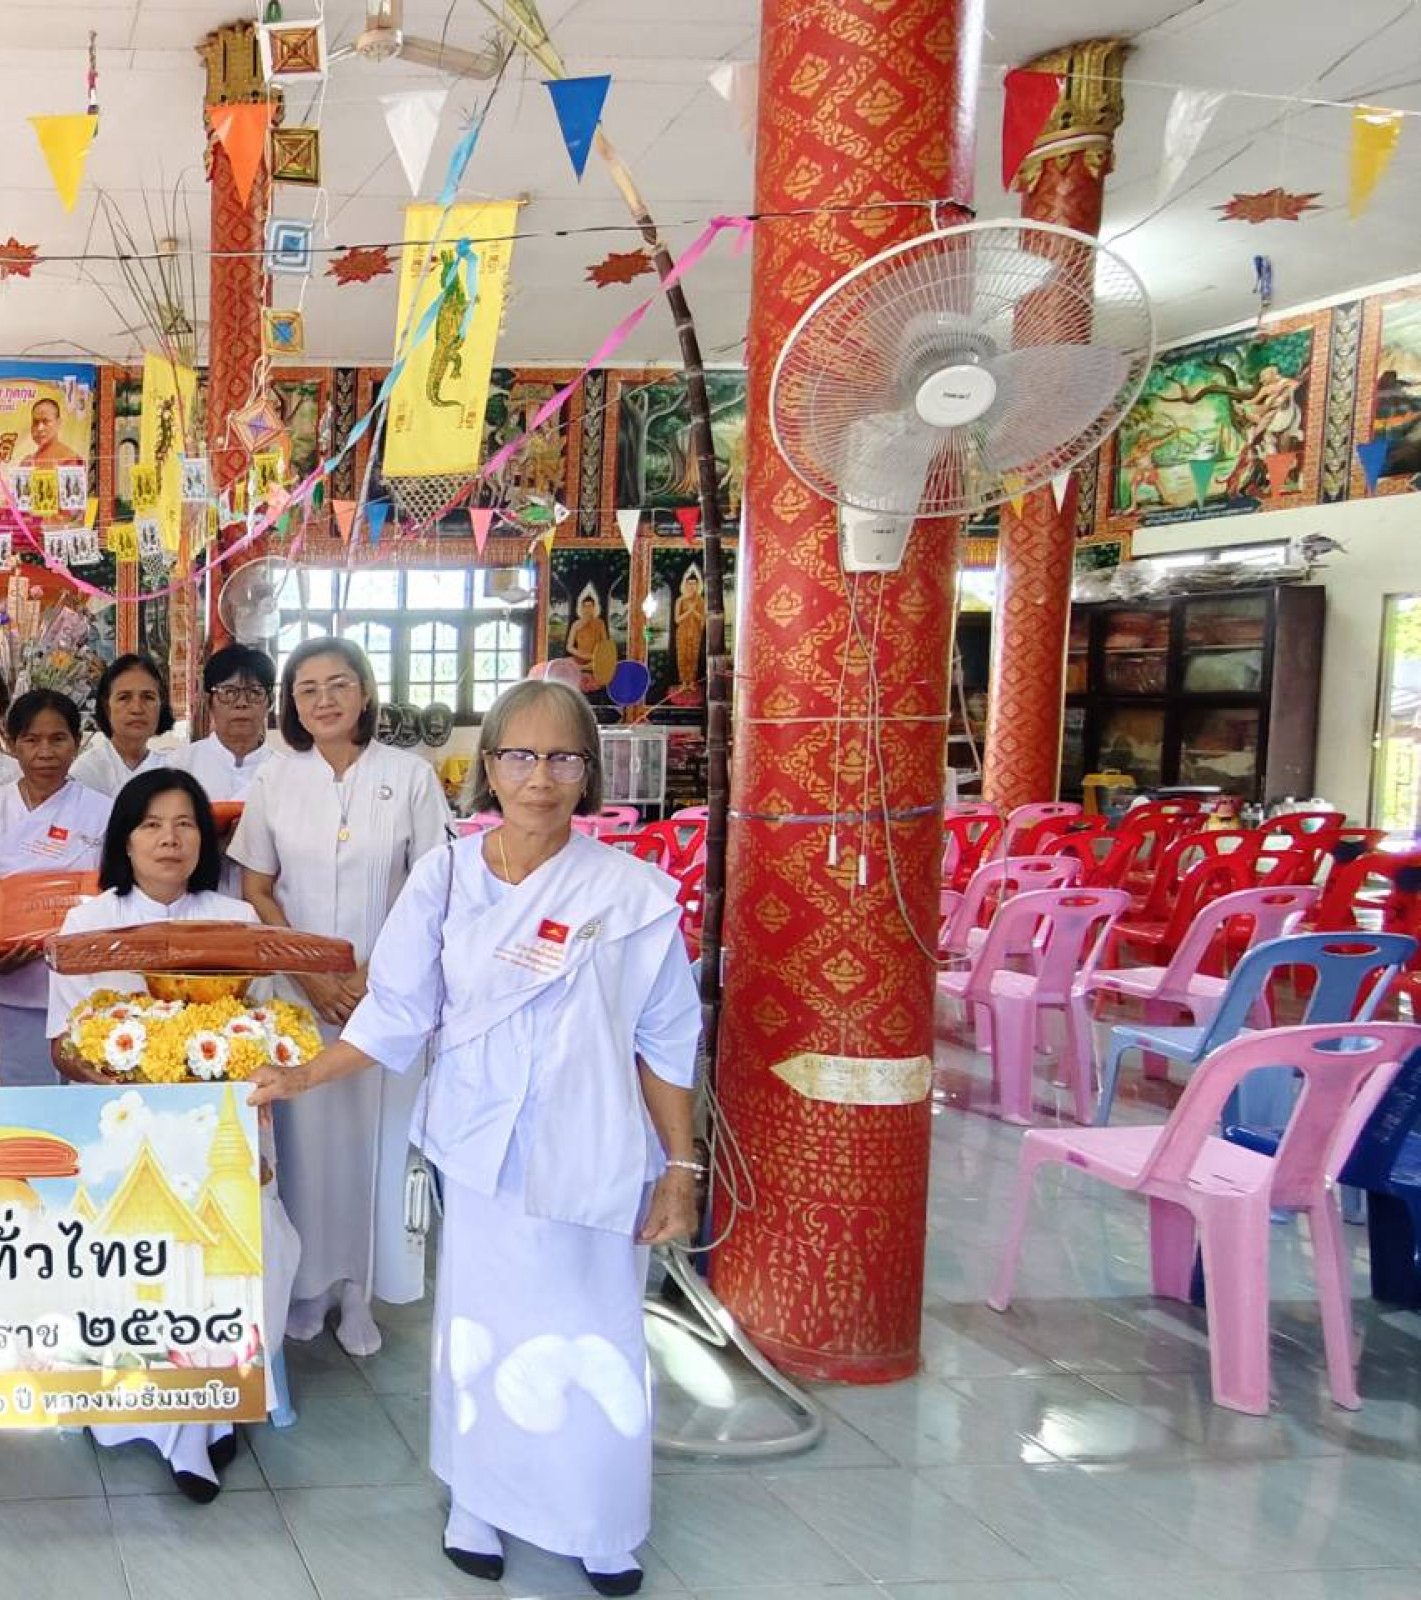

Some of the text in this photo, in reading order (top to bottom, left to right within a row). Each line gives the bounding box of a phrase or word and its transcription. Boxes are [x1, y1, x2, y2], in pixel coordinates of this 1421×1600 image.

[77, 1307, 243, 1347] ๒๕๖๘
[17, 1387, 32, 1411] ปี
[43, 1385, 239, 1410] หลวงพ่อธัมมชโย
